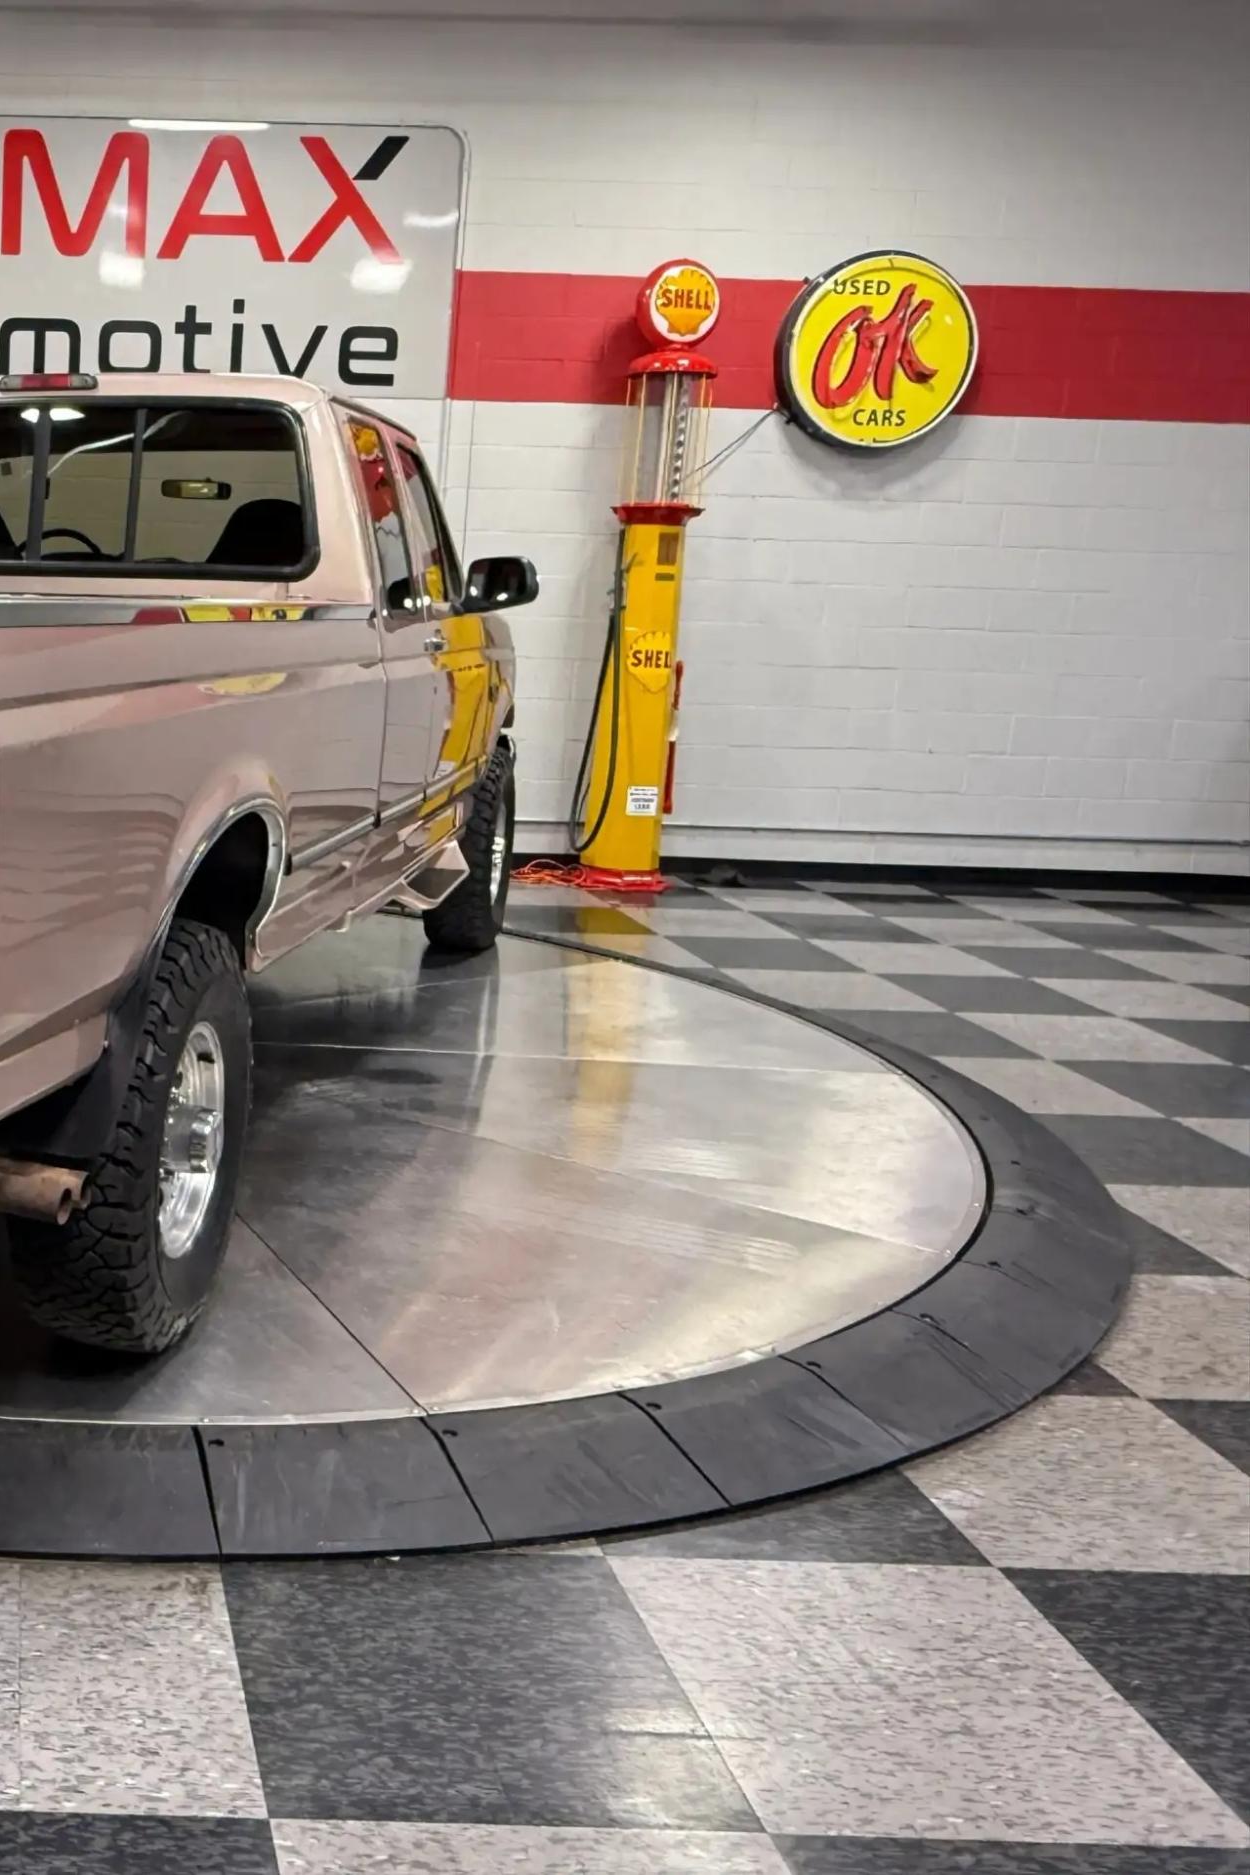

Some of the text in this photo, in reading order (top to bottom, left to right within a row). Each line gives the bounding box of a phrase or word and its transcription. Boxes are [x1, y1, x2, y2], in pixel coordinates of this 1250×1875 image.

[0, 128, 410, 263] MAX
[832, 279, 891, 296] USED
[660, 288, 712, 311] SHELL
[811, 283, 939, 409] OK
[852, 408, 906, 427] CARS
